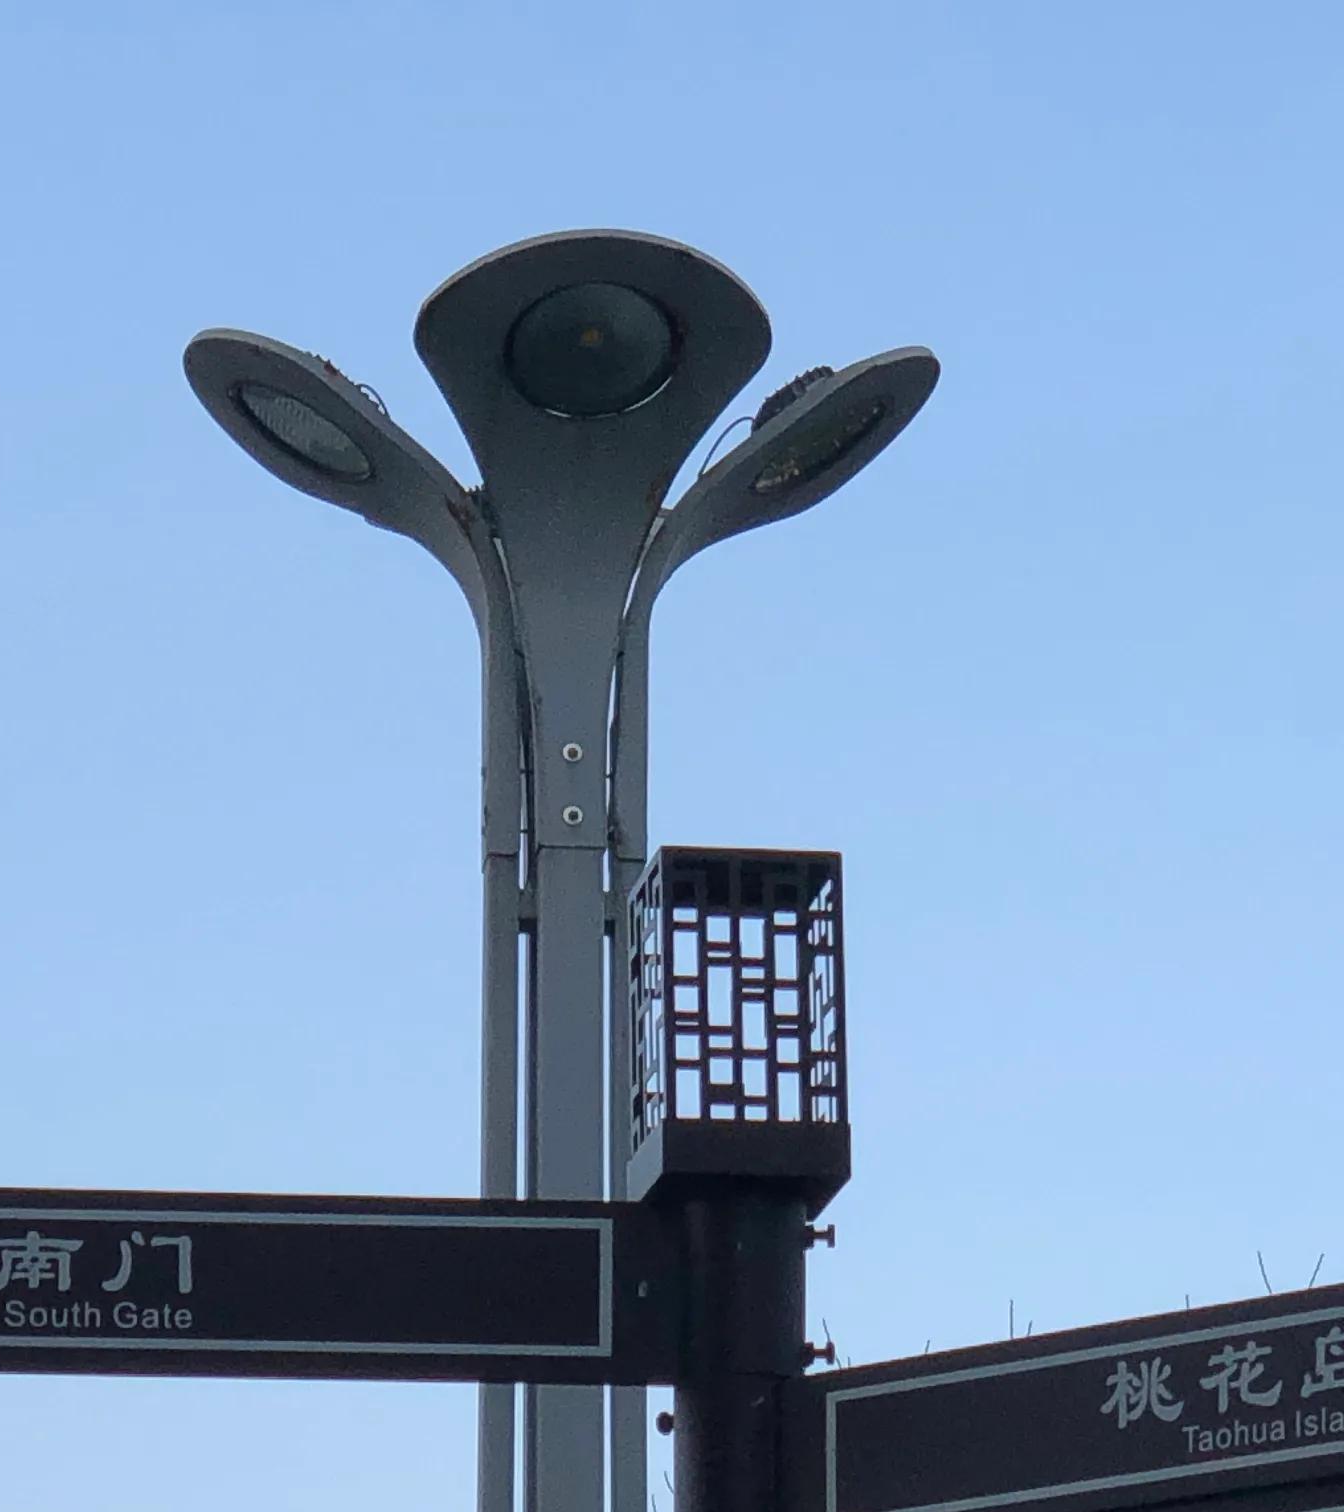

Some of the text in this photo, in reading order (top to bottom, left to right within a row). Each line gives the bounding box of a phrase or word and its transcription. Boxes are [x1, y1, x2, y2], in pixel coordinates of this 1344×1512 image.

[4, 1299, 193, 1329] South Gate
[1182, 1418, 1286, 1453] Taohua
